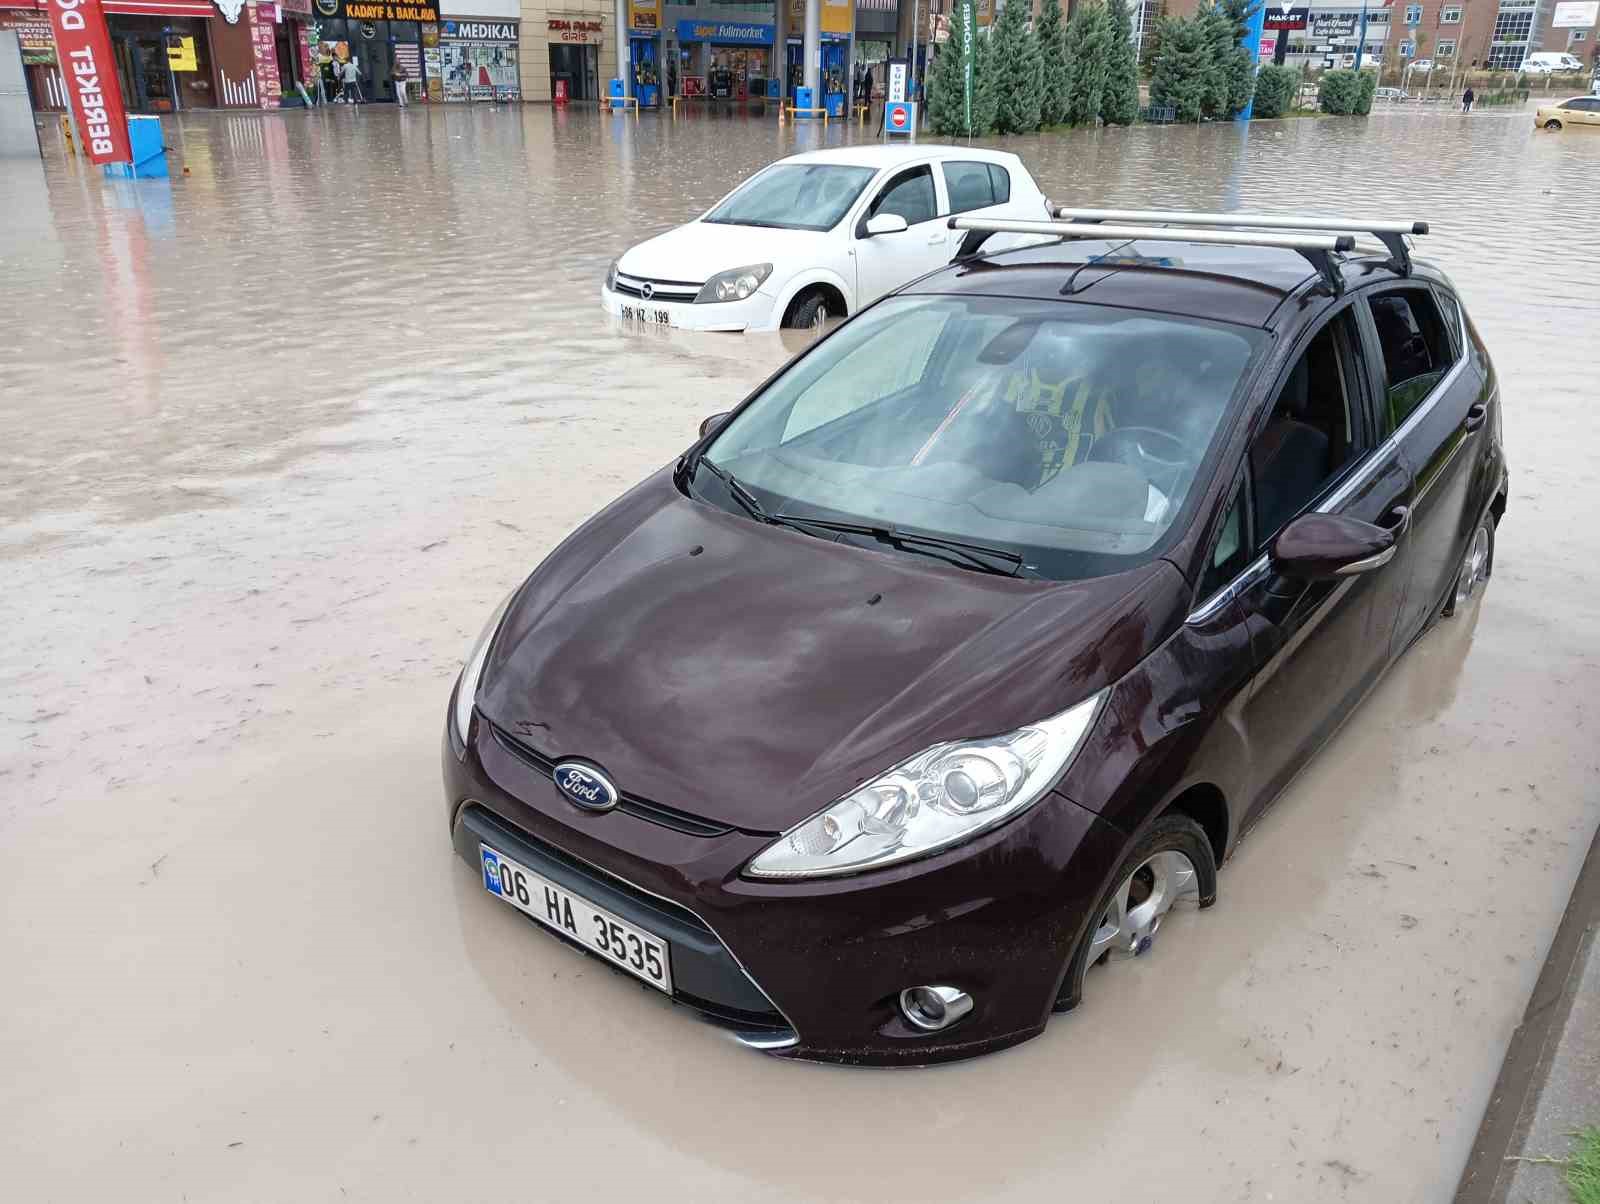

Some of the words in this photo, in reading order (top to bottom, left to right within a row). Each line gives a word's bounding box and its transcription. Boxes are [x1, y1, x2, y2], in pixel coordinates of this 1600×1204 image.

[346, 4, 384, 18] KADAYIF
[387, 6, 394, 18] &
[396, 7, 437, 20] BAKLAVA
[654, 309, 669, 324] 199
[563, 769, 599, 801] Ford
[499, 863, 530, 906] 06
[544, 881, 577, 934] HA
[593, 915, 663, 981] 3535
